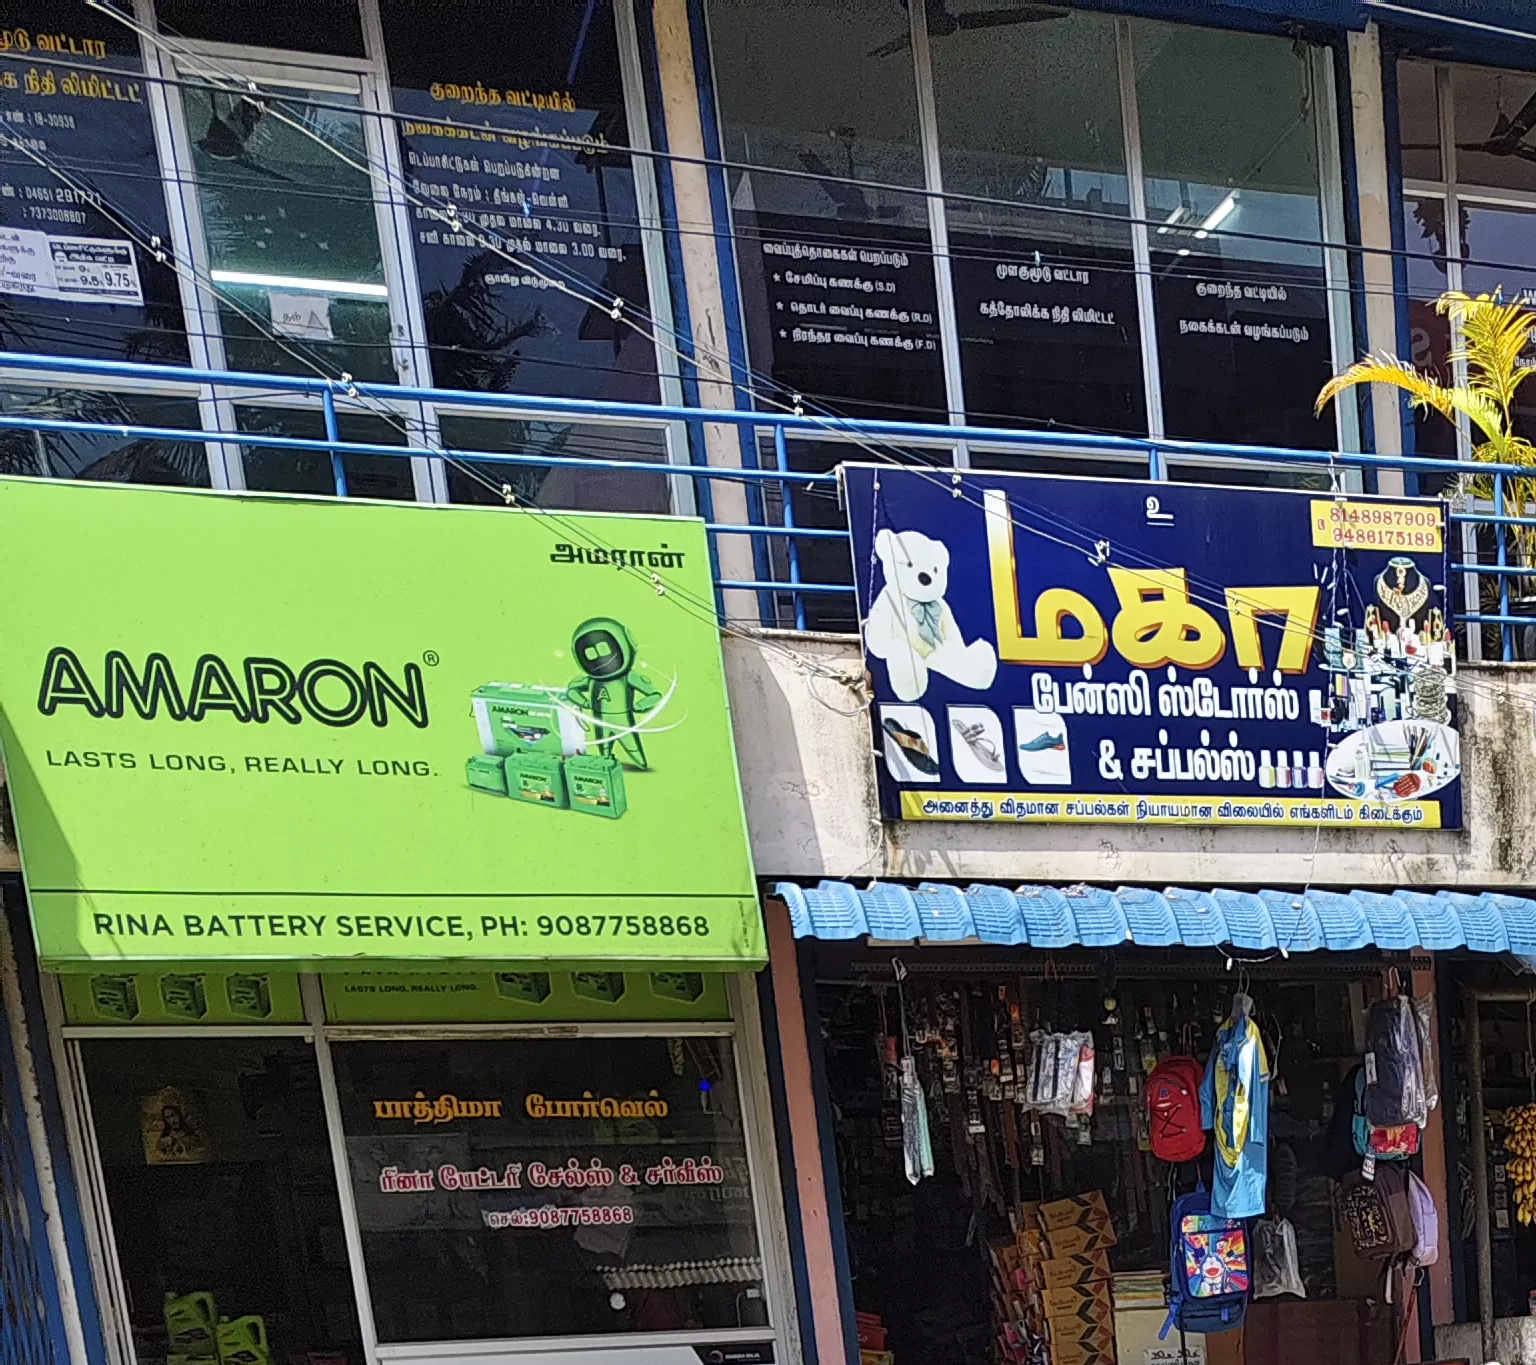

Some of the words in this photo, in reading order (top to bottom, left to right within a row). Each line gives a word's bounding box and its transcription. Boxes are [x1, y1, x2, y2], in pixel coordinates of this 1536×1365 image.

[1196, 281, 1242, 299] குறைந்த
[1243, 285, 1287, 303] வட்டியில்
[1179, 319, 1242, 335] நகைக்கடன்
[1243, 323, 1310, 343] வழங்கப்படும்
[1329, 506, 1437, 527] 8148987909
[1333, 527, 1436, 548] 9486175189
[550, 543, 685, 572] அமரான்
[983, 489, 1320, 675] மகா
[37, 646, 429, 729] AMARON
[1031, 663, 1152, 717] பேன்ஸி
[1158, 665, 1300, 720] ஸ்டோர்ஸ்
[46, 749, 137, 769] LASTS
[149, 753, 236, 775] LONG,
[245, 756, 345, 775] REALLY
[356, 758, 439, 777] LONG.
[1098, 739, 1124, 781] &
[1130, 729, 1256, 782] சப்பல்ஸ்
[923, 798, 994, 818] அனைத்து
[1000, 798, 1059, 818] விதமான
[1066, 799, 1130, 816] சப்பல்கள்
[1136, 800, 1213, 821] நியாயமான
[1218, 802, 1284, 820] விலையில்
[1290, 804, 1354, 821] எங்களிடம்
[1358, 805, 1423, 824] கிடைக்கும்
[93, 913, 174, 936] RINA
[183, 914, 327, 937] BATTERY
[337, 914, 473, 941] SERVICE,
[481, 915, 529, 937] PH:
[537, 915, 711, 937] 9087758868
[373, 1090, 503, 1125] பாத்திமா
[525, 1089, 669, 1120] போர்வெல்
[526, 1158, 614, 1188] சேல்ஸ்
[618, 1162, 640, 1185] &
[645, 1155, 725, 1186] சர்வீஸ்
